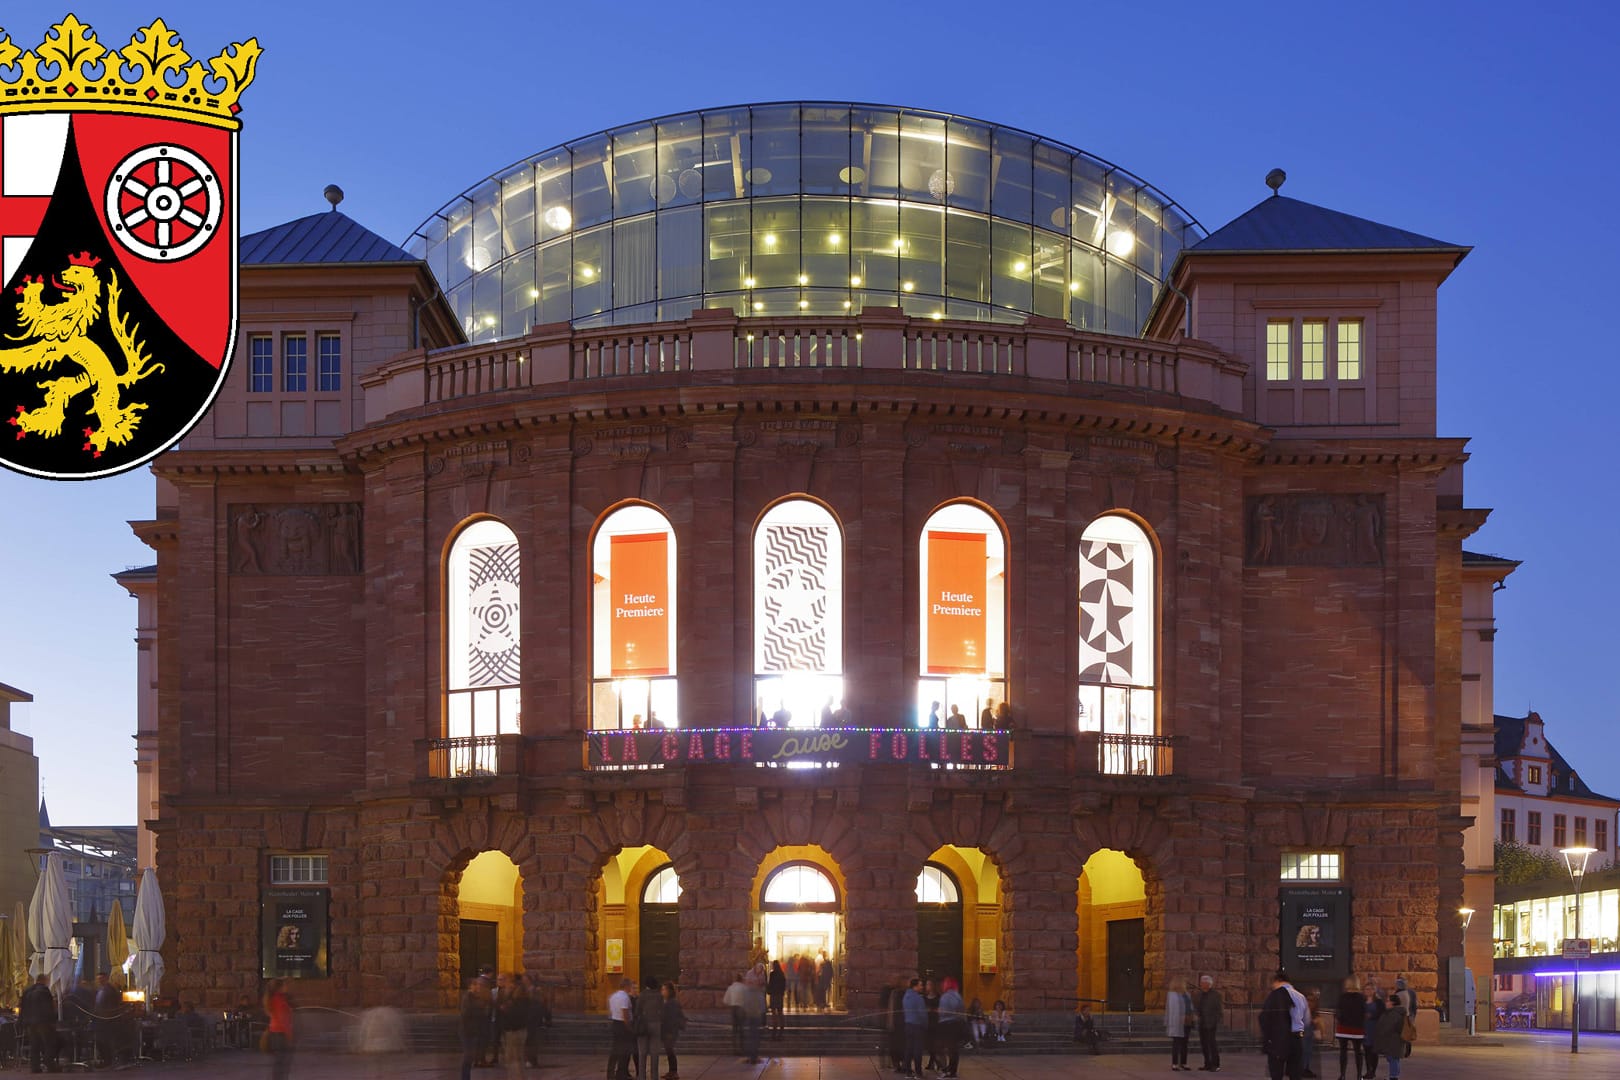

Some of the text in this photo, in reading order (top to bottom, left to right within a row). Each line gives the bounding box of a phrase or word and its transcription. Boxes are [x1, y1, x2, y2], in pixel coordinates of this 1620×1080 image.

[624, 593, 655, 604] Heute
[941, 591, 973, 603] Heute
[616, 606, 664, 618] Premiere
[933, 604, 981, 616] Premiere
[602, 735, 638, 762] LA
[662, 733, 752, 760] CAGE
[870, 733, 998, 761] FOLLES
